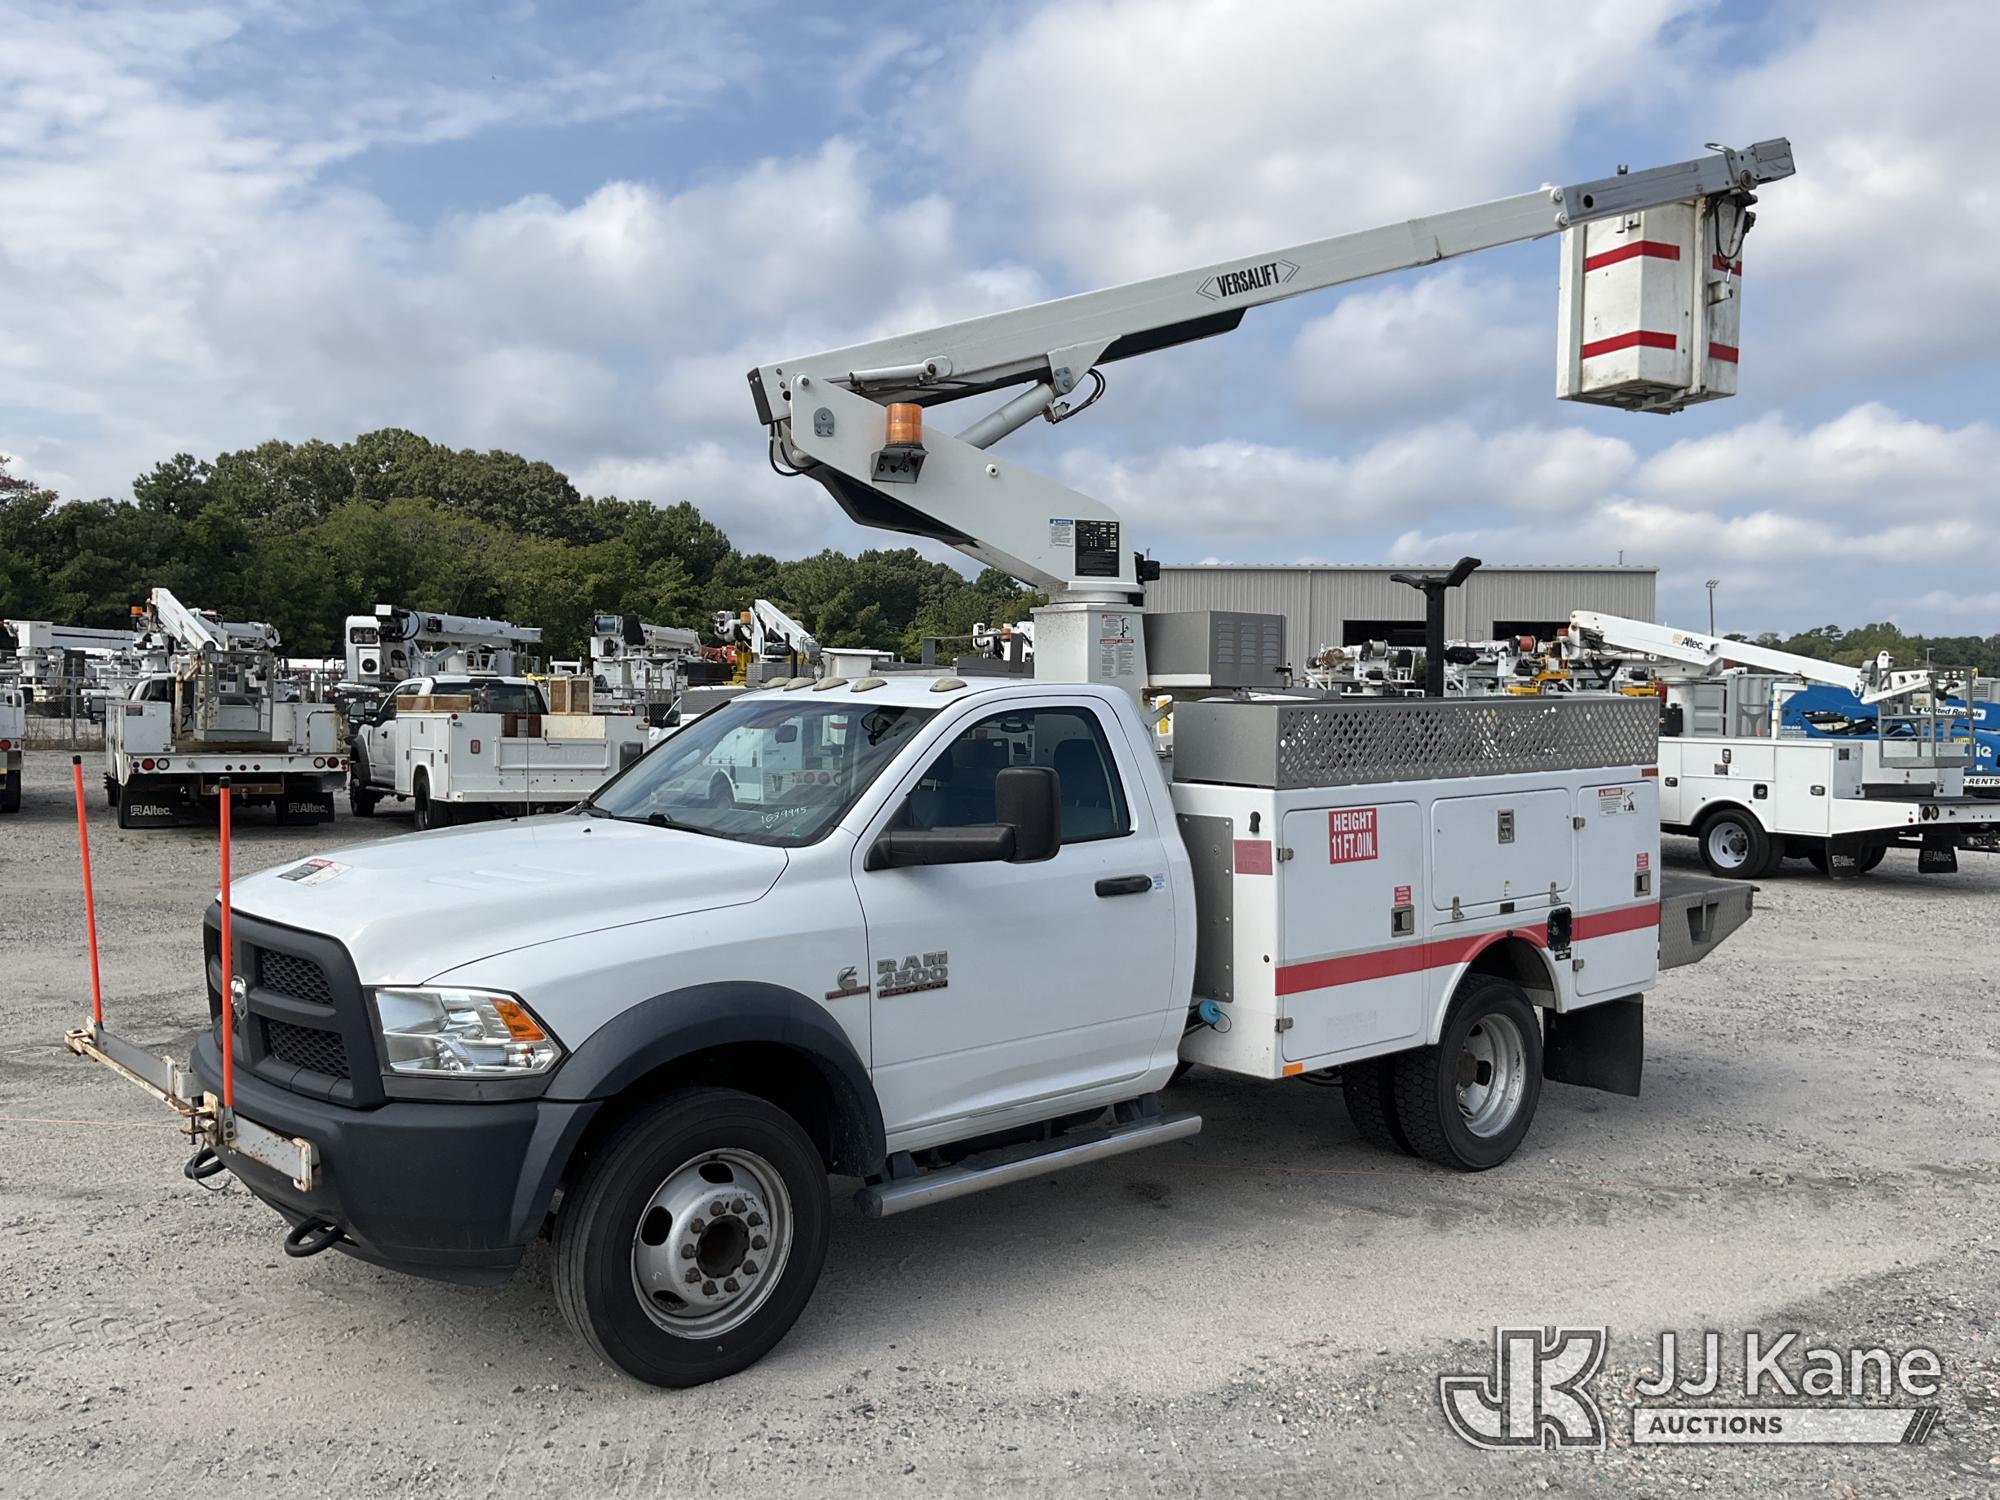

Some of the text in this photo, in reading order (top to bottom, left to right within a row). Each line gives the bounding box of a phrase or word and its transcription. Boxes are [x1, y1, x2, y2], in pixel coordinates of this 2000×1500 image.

[1216, 263, 1279, 297] VERSALIFT
[1681, 636, 1704, 650] Altec
[142, 805, 172, 816] Altec
[300, 804, 328, 814] Altec
[1333, 811, 1373, 832] HEIGHT
[877, 951, 948, 974] RAM
[877, 965, 948, 987] 4500
